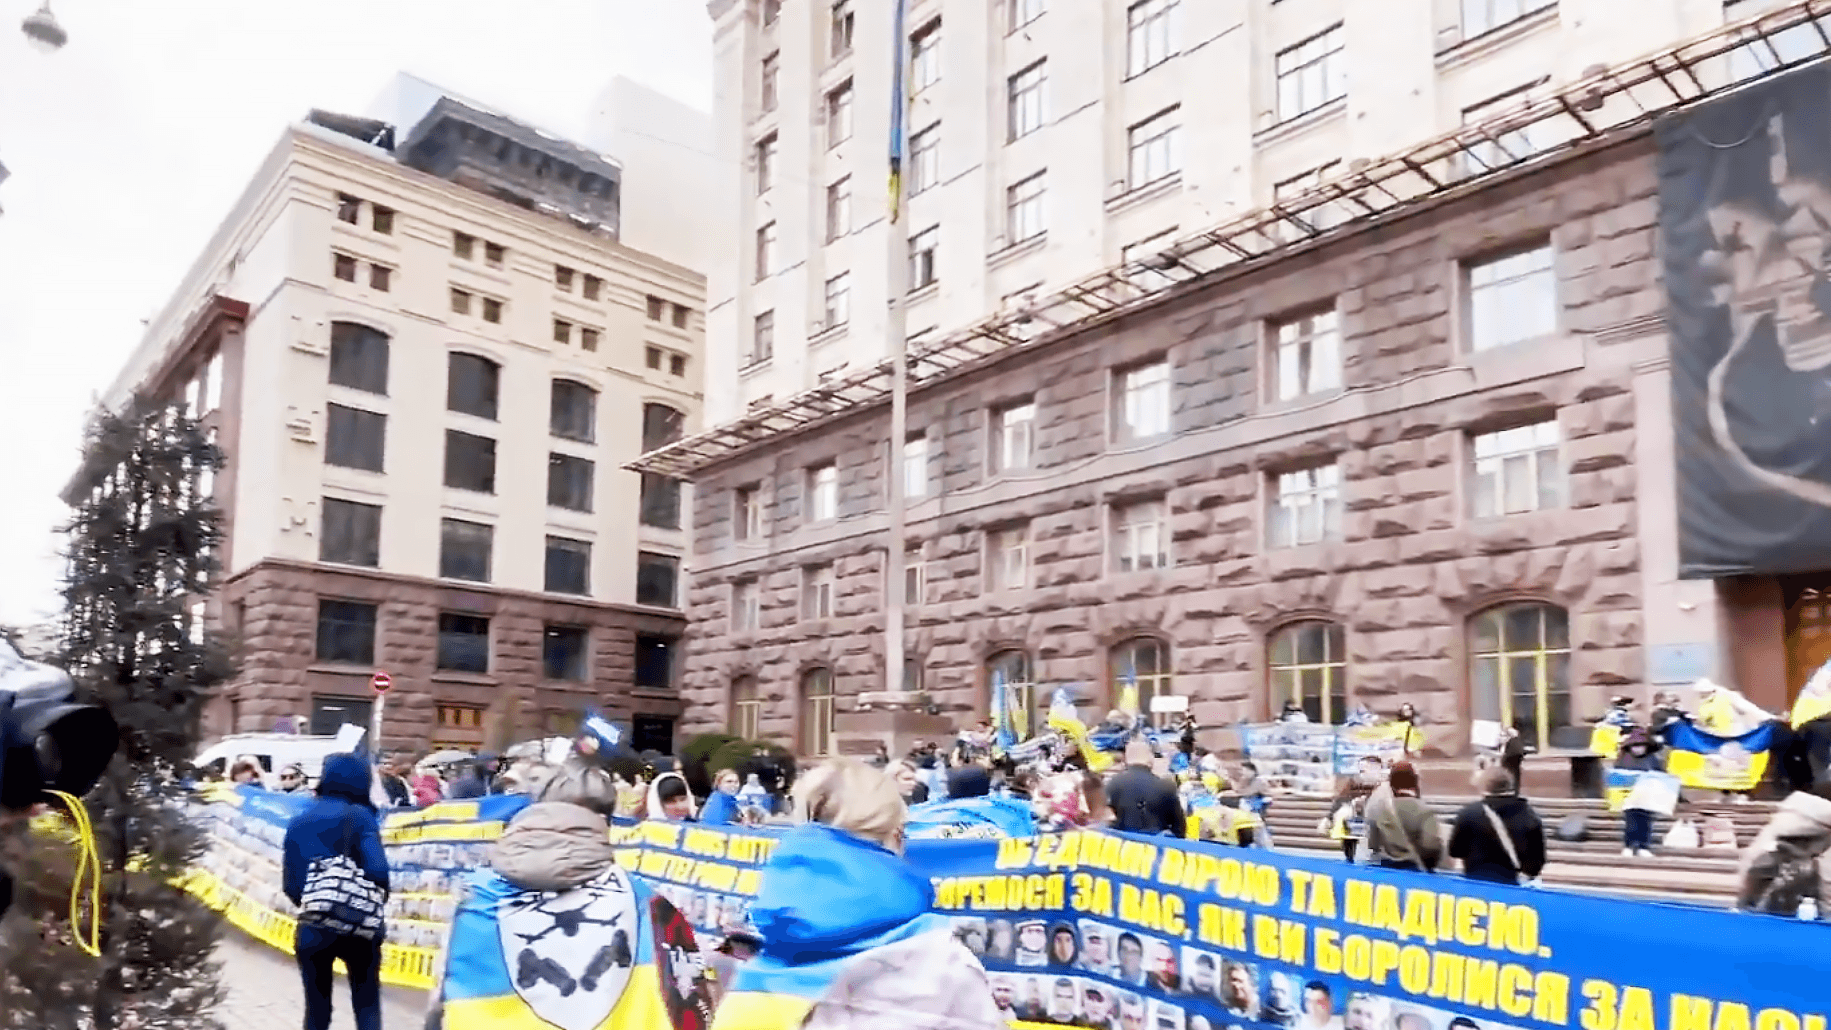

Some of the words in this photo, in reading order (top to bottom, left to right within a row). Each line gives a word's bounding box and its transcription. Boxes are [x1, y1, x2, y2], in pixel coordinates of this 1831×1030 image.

[1071, 872, 1113, 917] ЗА
[1118, 882, 1192, 941] ВАС,
[1198, 902, 1247, 952] ЯК
[1252, 913, 1306, 966] ВИ
[1314, 926, 1570, 1025] БОРОЛИСЯ
[1580, 978, 1655, 1030] ЗА
[1670, 993, 1828, 1030] НА
[1158, 847, 1280, 907] ВІРОЮ
[1286, 869, 1336, 919] ТА
[1344, 878, 1552, 957] НАДІЄЮ.
